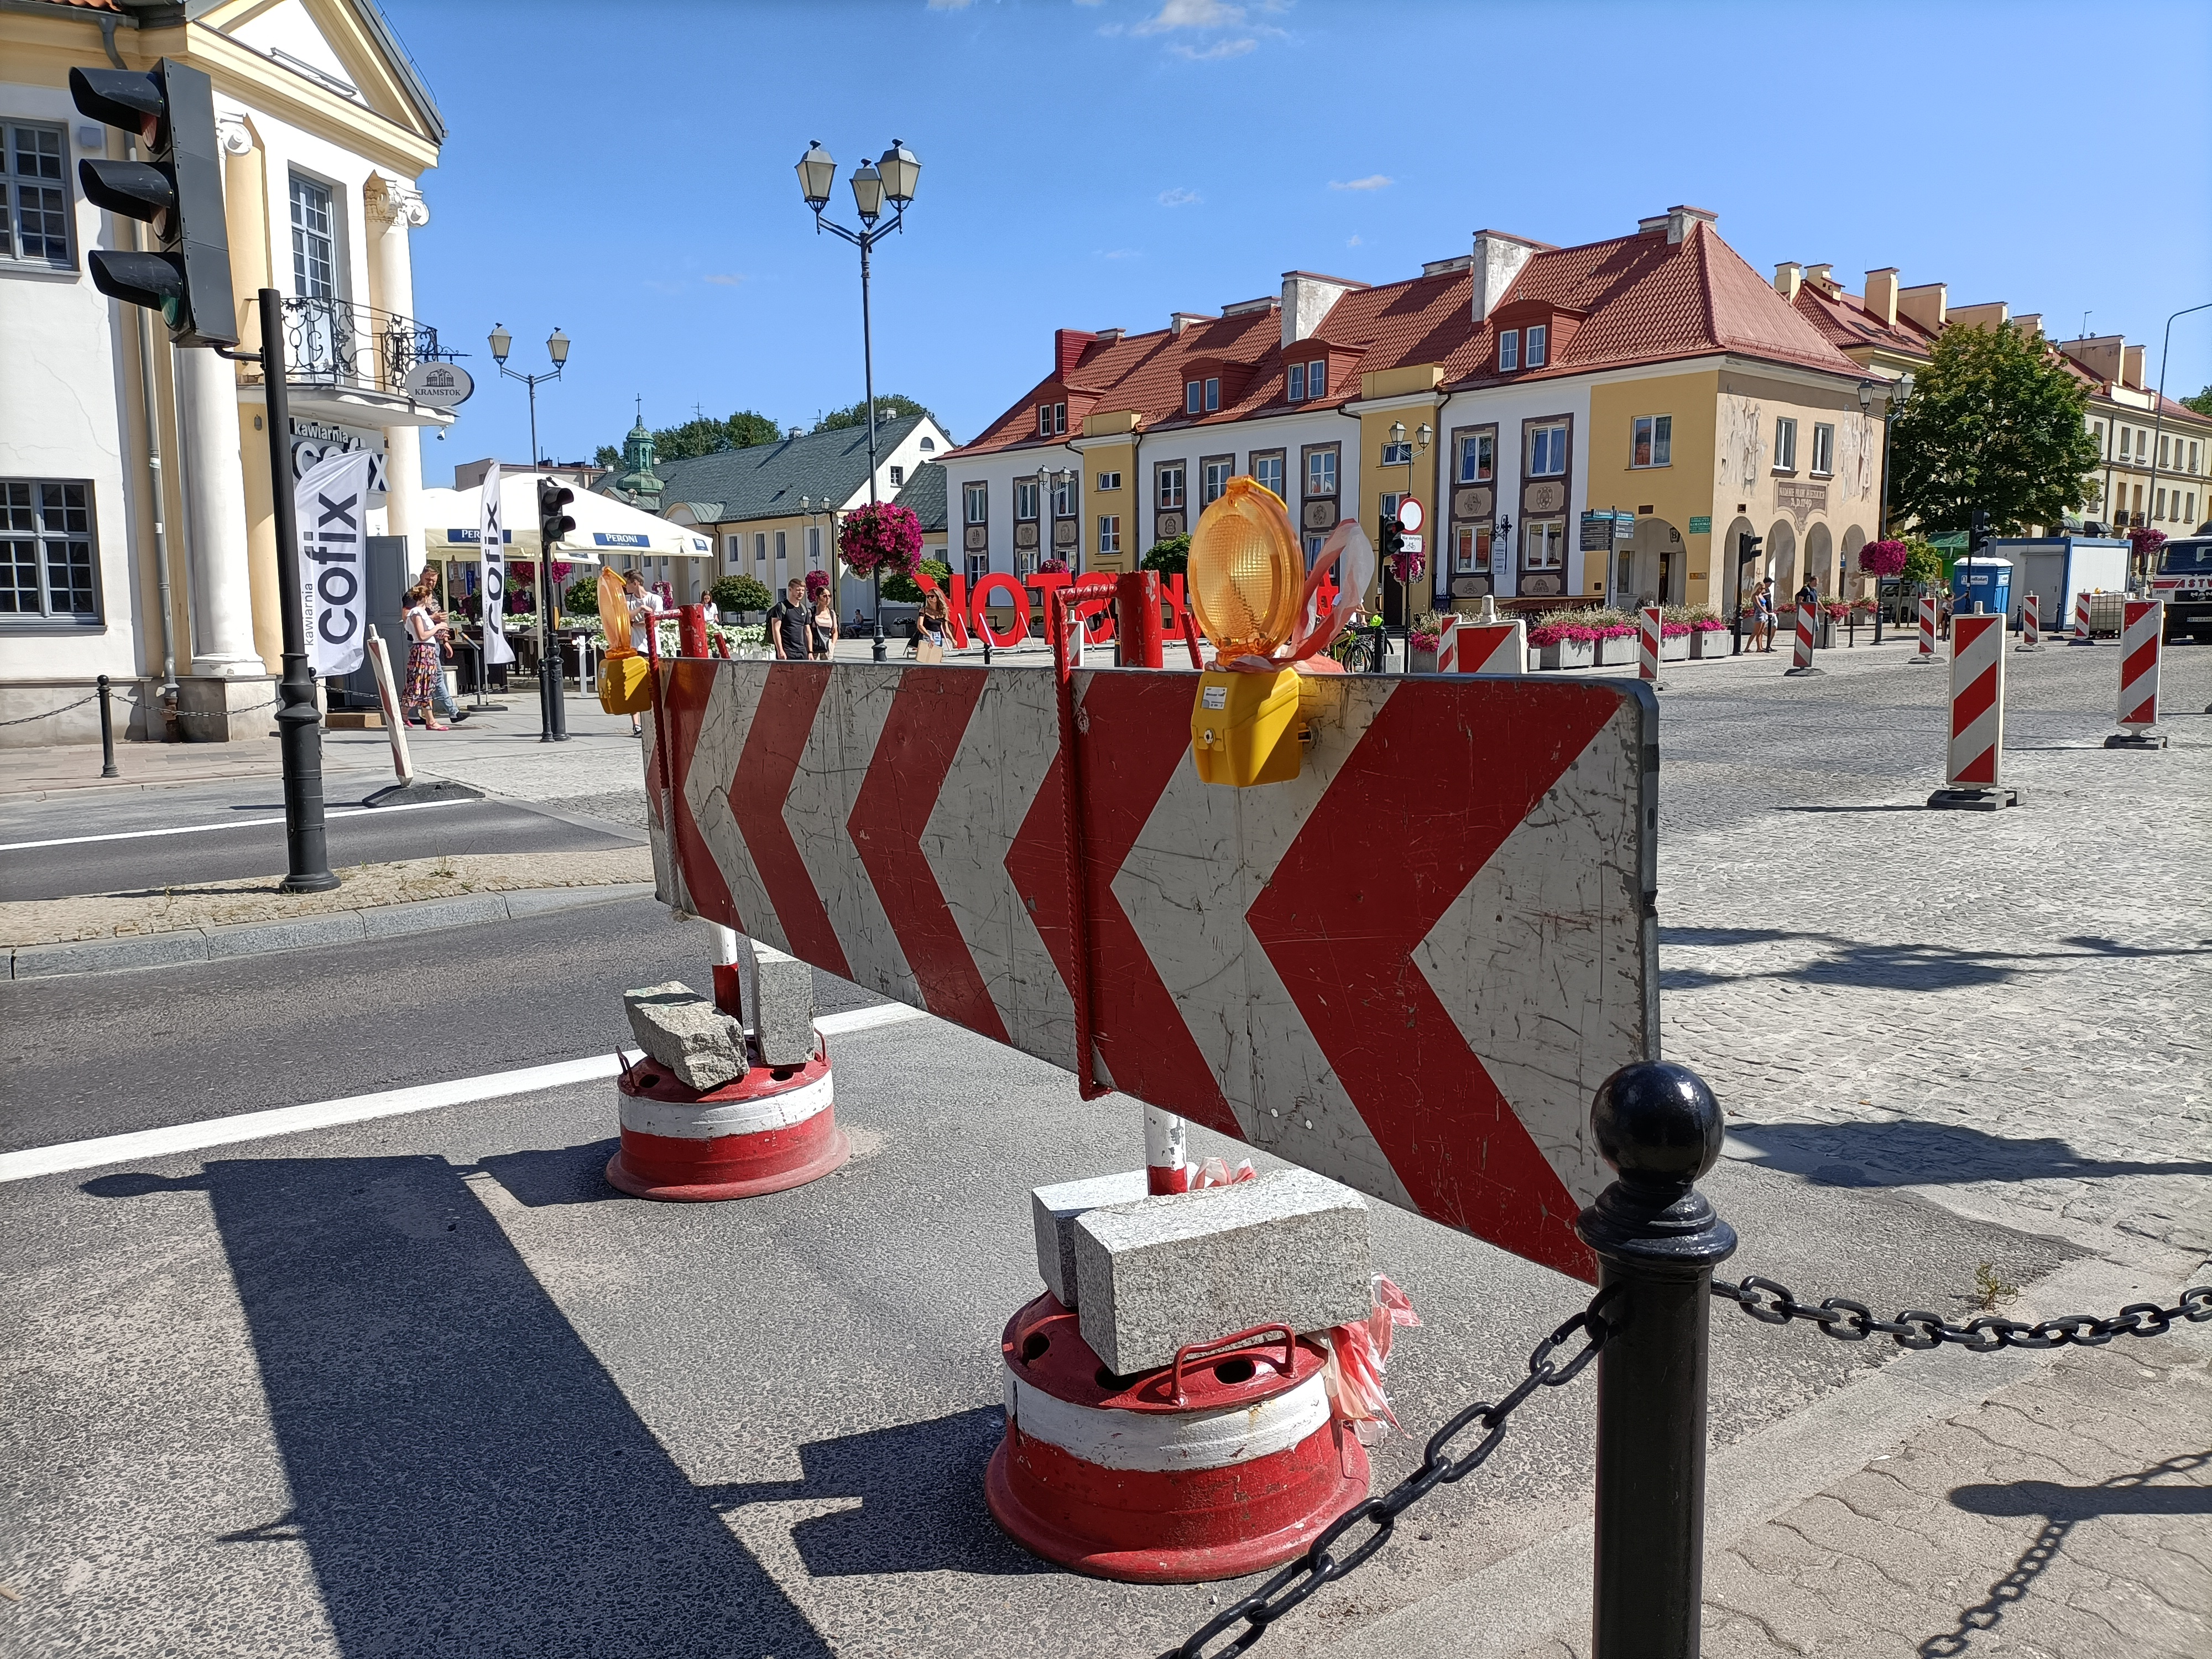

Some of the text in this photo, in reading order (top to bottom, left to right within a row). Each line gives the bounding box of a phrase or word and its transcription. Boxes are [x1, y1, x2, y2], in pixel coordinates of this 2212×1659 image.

[415, 388, 461, 397] KRAMSTOK
[294, 418, 349, 443] kawiarnia
[461, 529, 481, 539] PER
[605, 533, 638, 543] PERONI
[304, 492, 358, 645] cofix
[301, 583, 314, 646] kawiarnia
